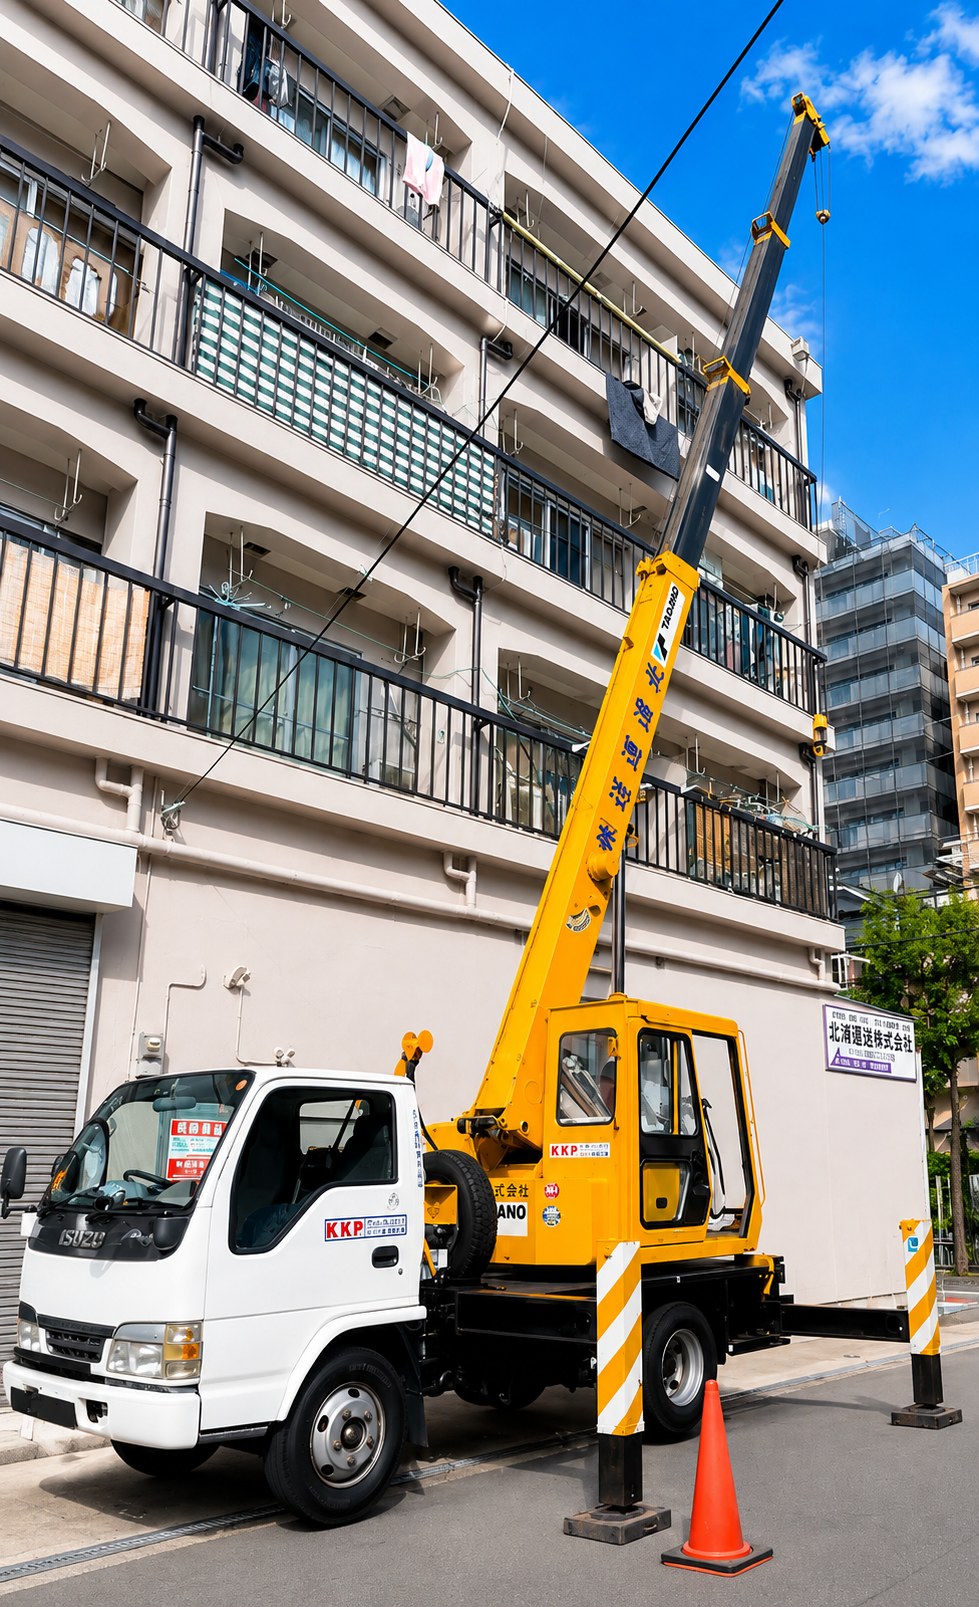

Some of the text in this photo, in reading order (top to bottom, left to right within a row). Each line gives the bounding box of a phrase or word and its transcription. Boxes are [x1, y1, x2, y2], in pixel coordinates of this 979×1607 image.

[551, 1145, 578, 1156] KKP
[59, 1229, 106, 1249] ISUZU
[326, 1220, 363, 1239] KKP
